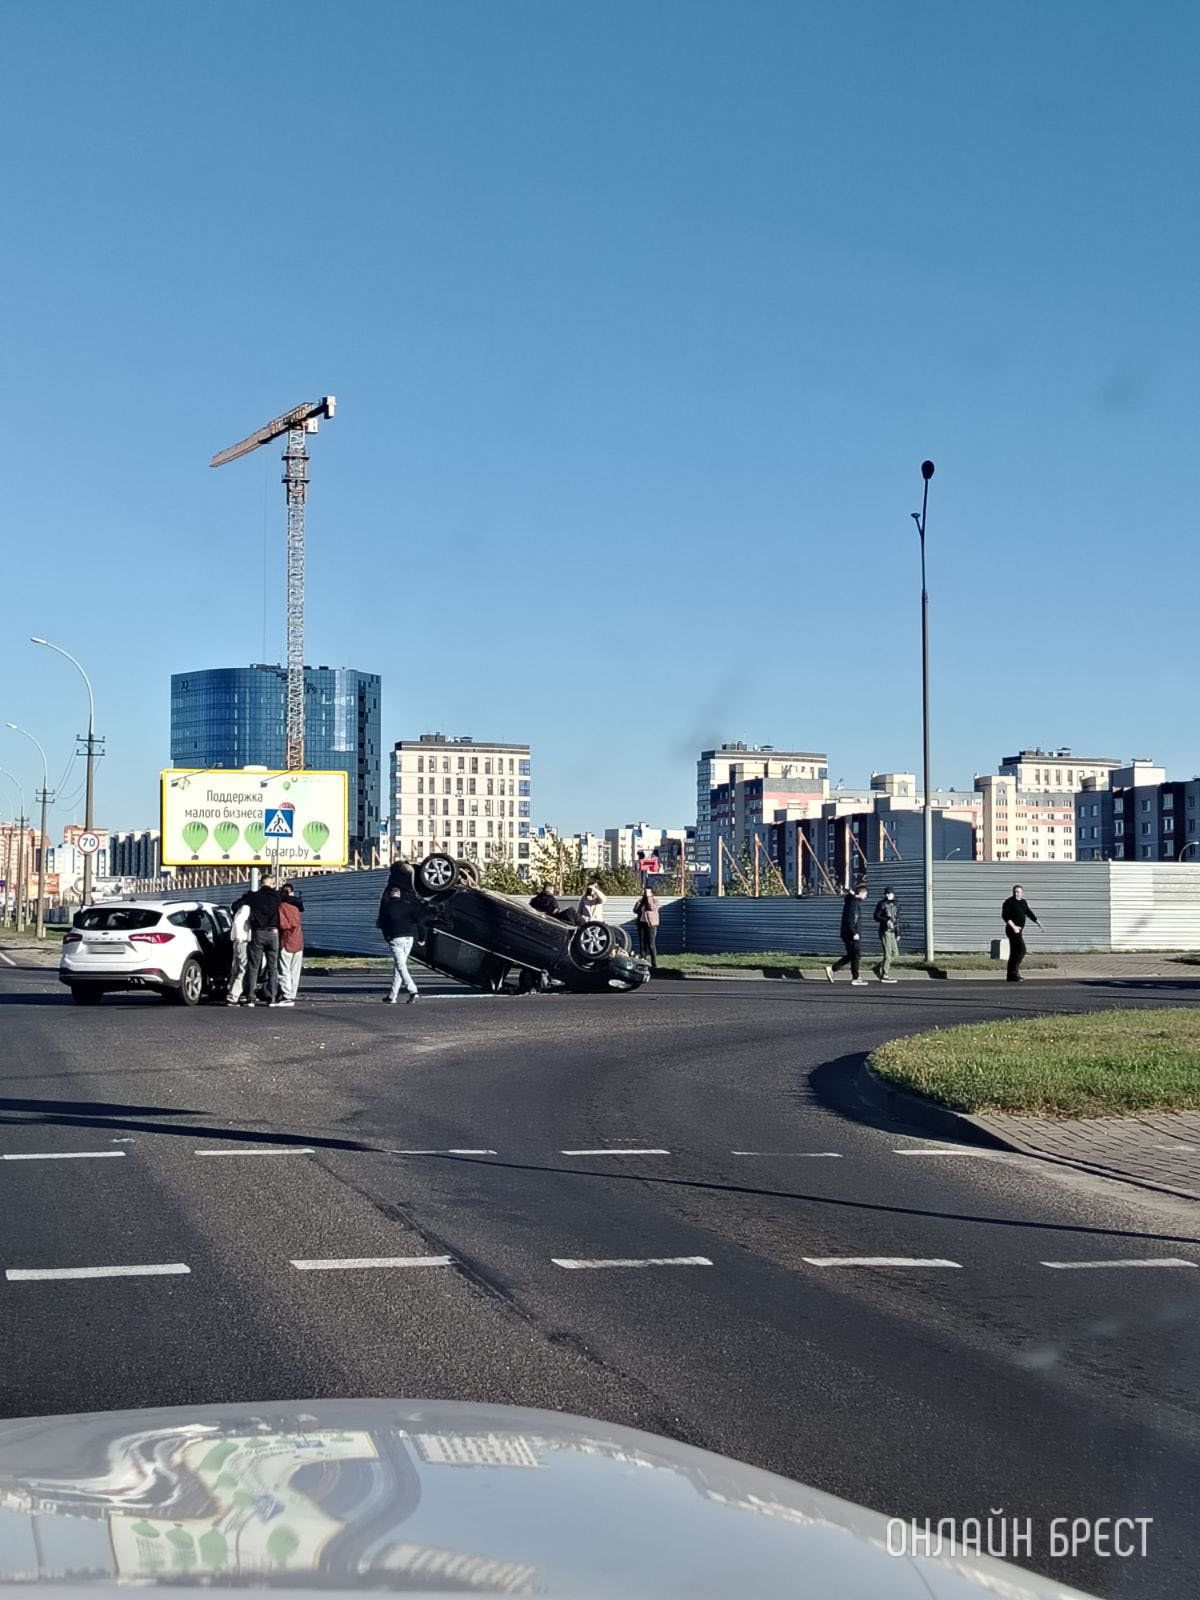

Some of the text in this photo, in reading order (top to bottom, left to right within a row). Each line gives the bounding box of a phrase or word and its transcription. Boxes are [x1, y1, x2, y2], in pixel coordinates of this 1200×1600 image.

[206, 789, 263, 804] Поддержка
[185, 806, 263, 818] малого бизнеса
[82, 837, 96, 847] 70
[265, 844, 309, 860] bearp.by
